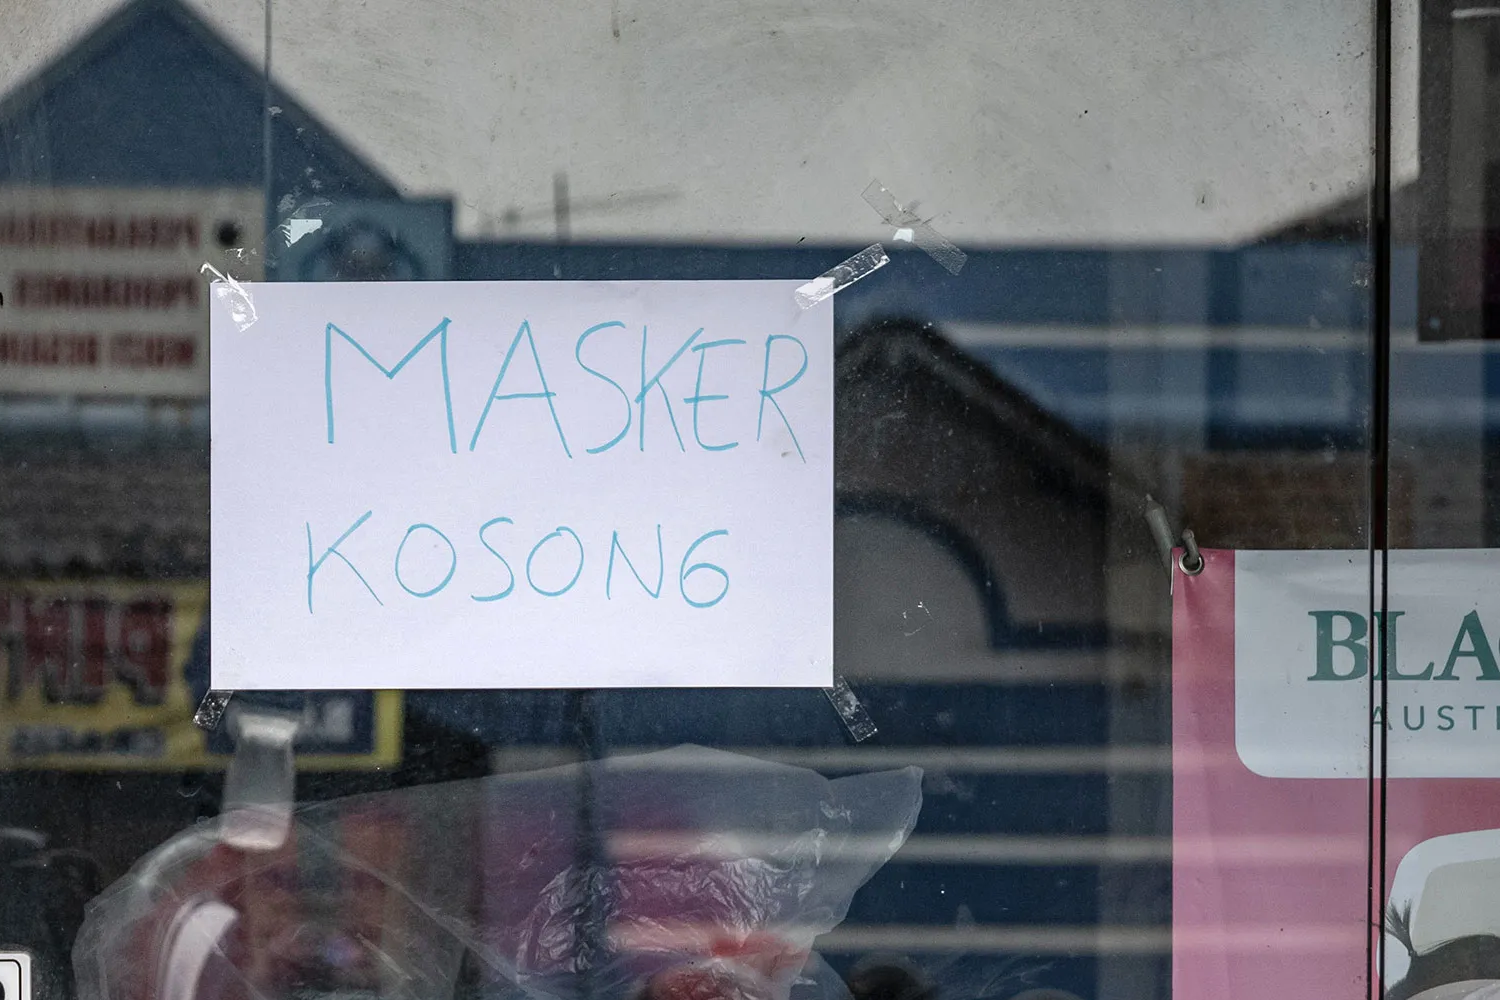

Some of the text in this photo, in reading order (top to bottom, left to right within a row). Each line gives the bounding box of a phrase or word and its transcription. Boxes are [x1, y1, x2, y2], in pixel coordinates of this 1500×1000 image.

[325, 317, 808, 463] MASKER
[305, 511, 731, 614] KOSONG
[1307, 610, 1500, 681] BLA
[1370, 705, 1500, 731] AUST
